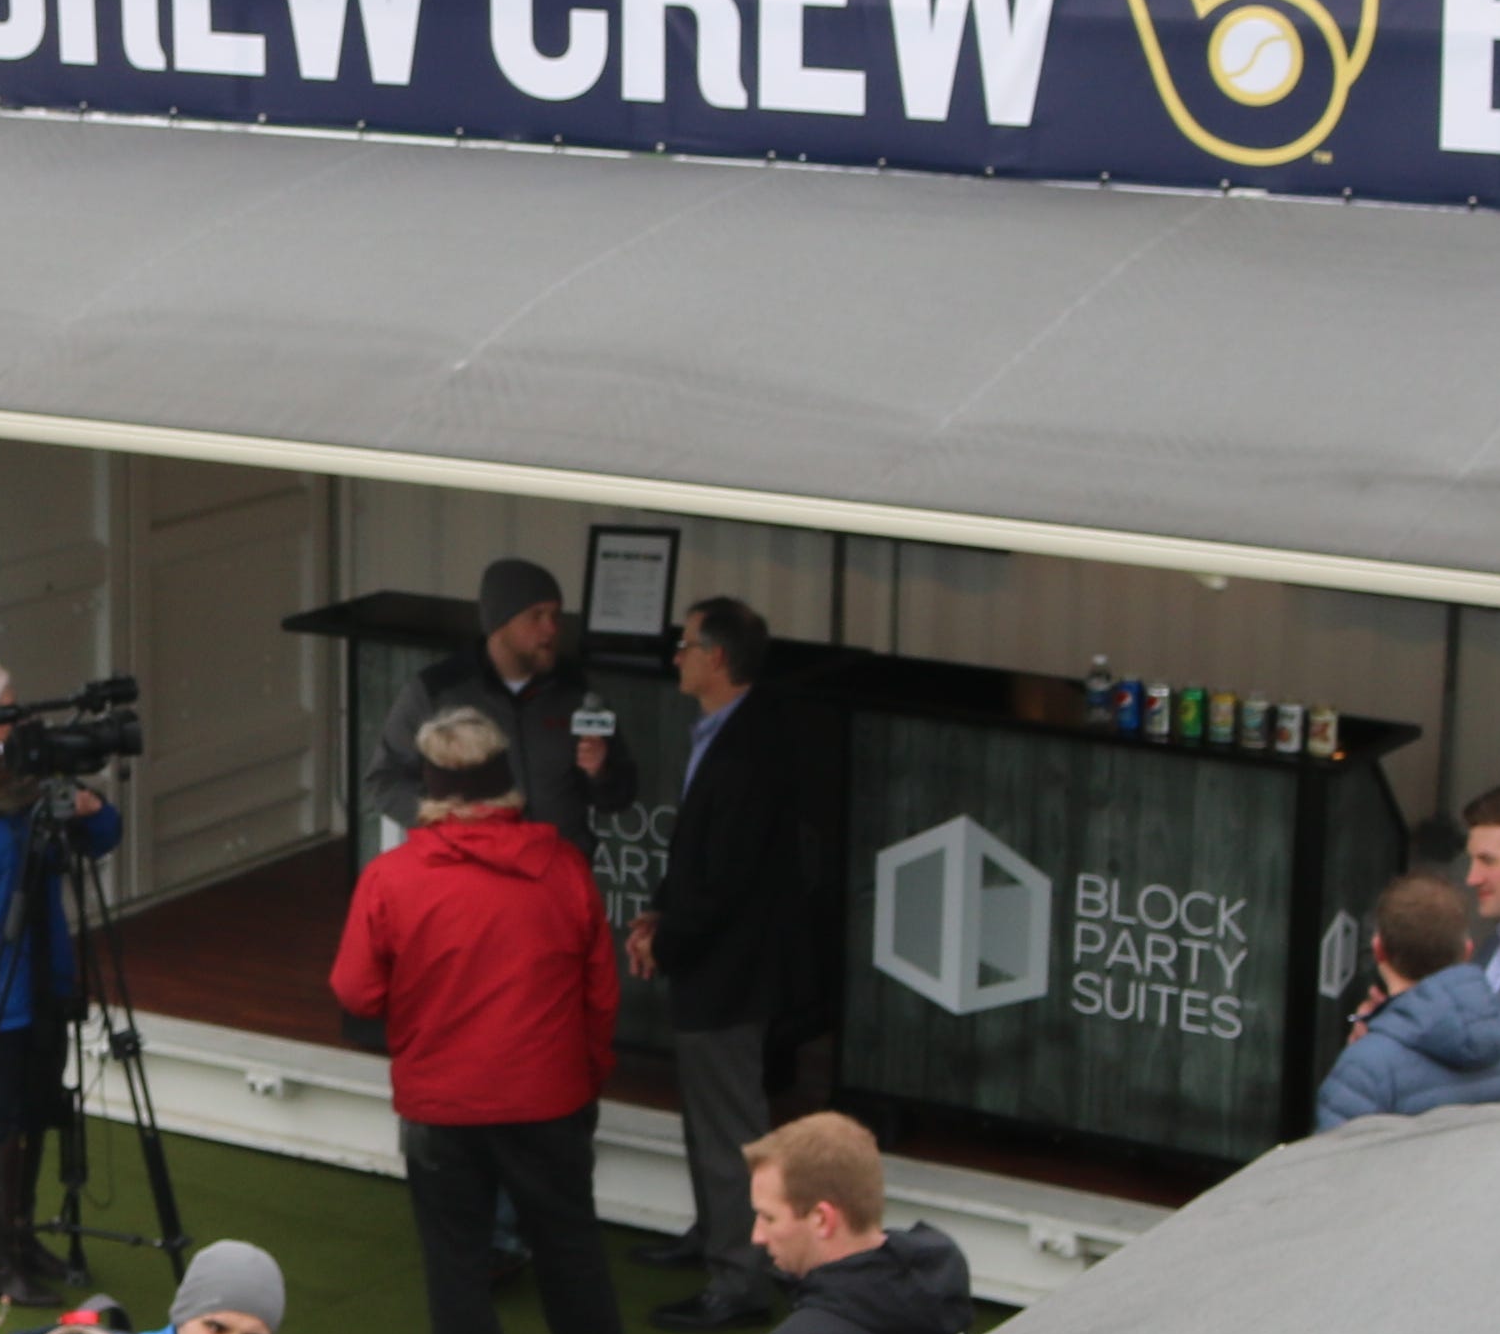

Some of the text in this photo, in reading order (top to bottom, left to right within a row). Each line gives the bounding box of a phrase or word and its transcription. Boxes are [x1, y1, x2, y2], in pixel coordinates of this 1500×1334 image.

[587, 801, 678, 848] LOC
[592, 841, 670, 888] ART
[1075, 872, 1248, 943] BLOCK
[1072, 920, 1248, 990] PARTY
[1070, 970, 1243, 1040] SUITES
